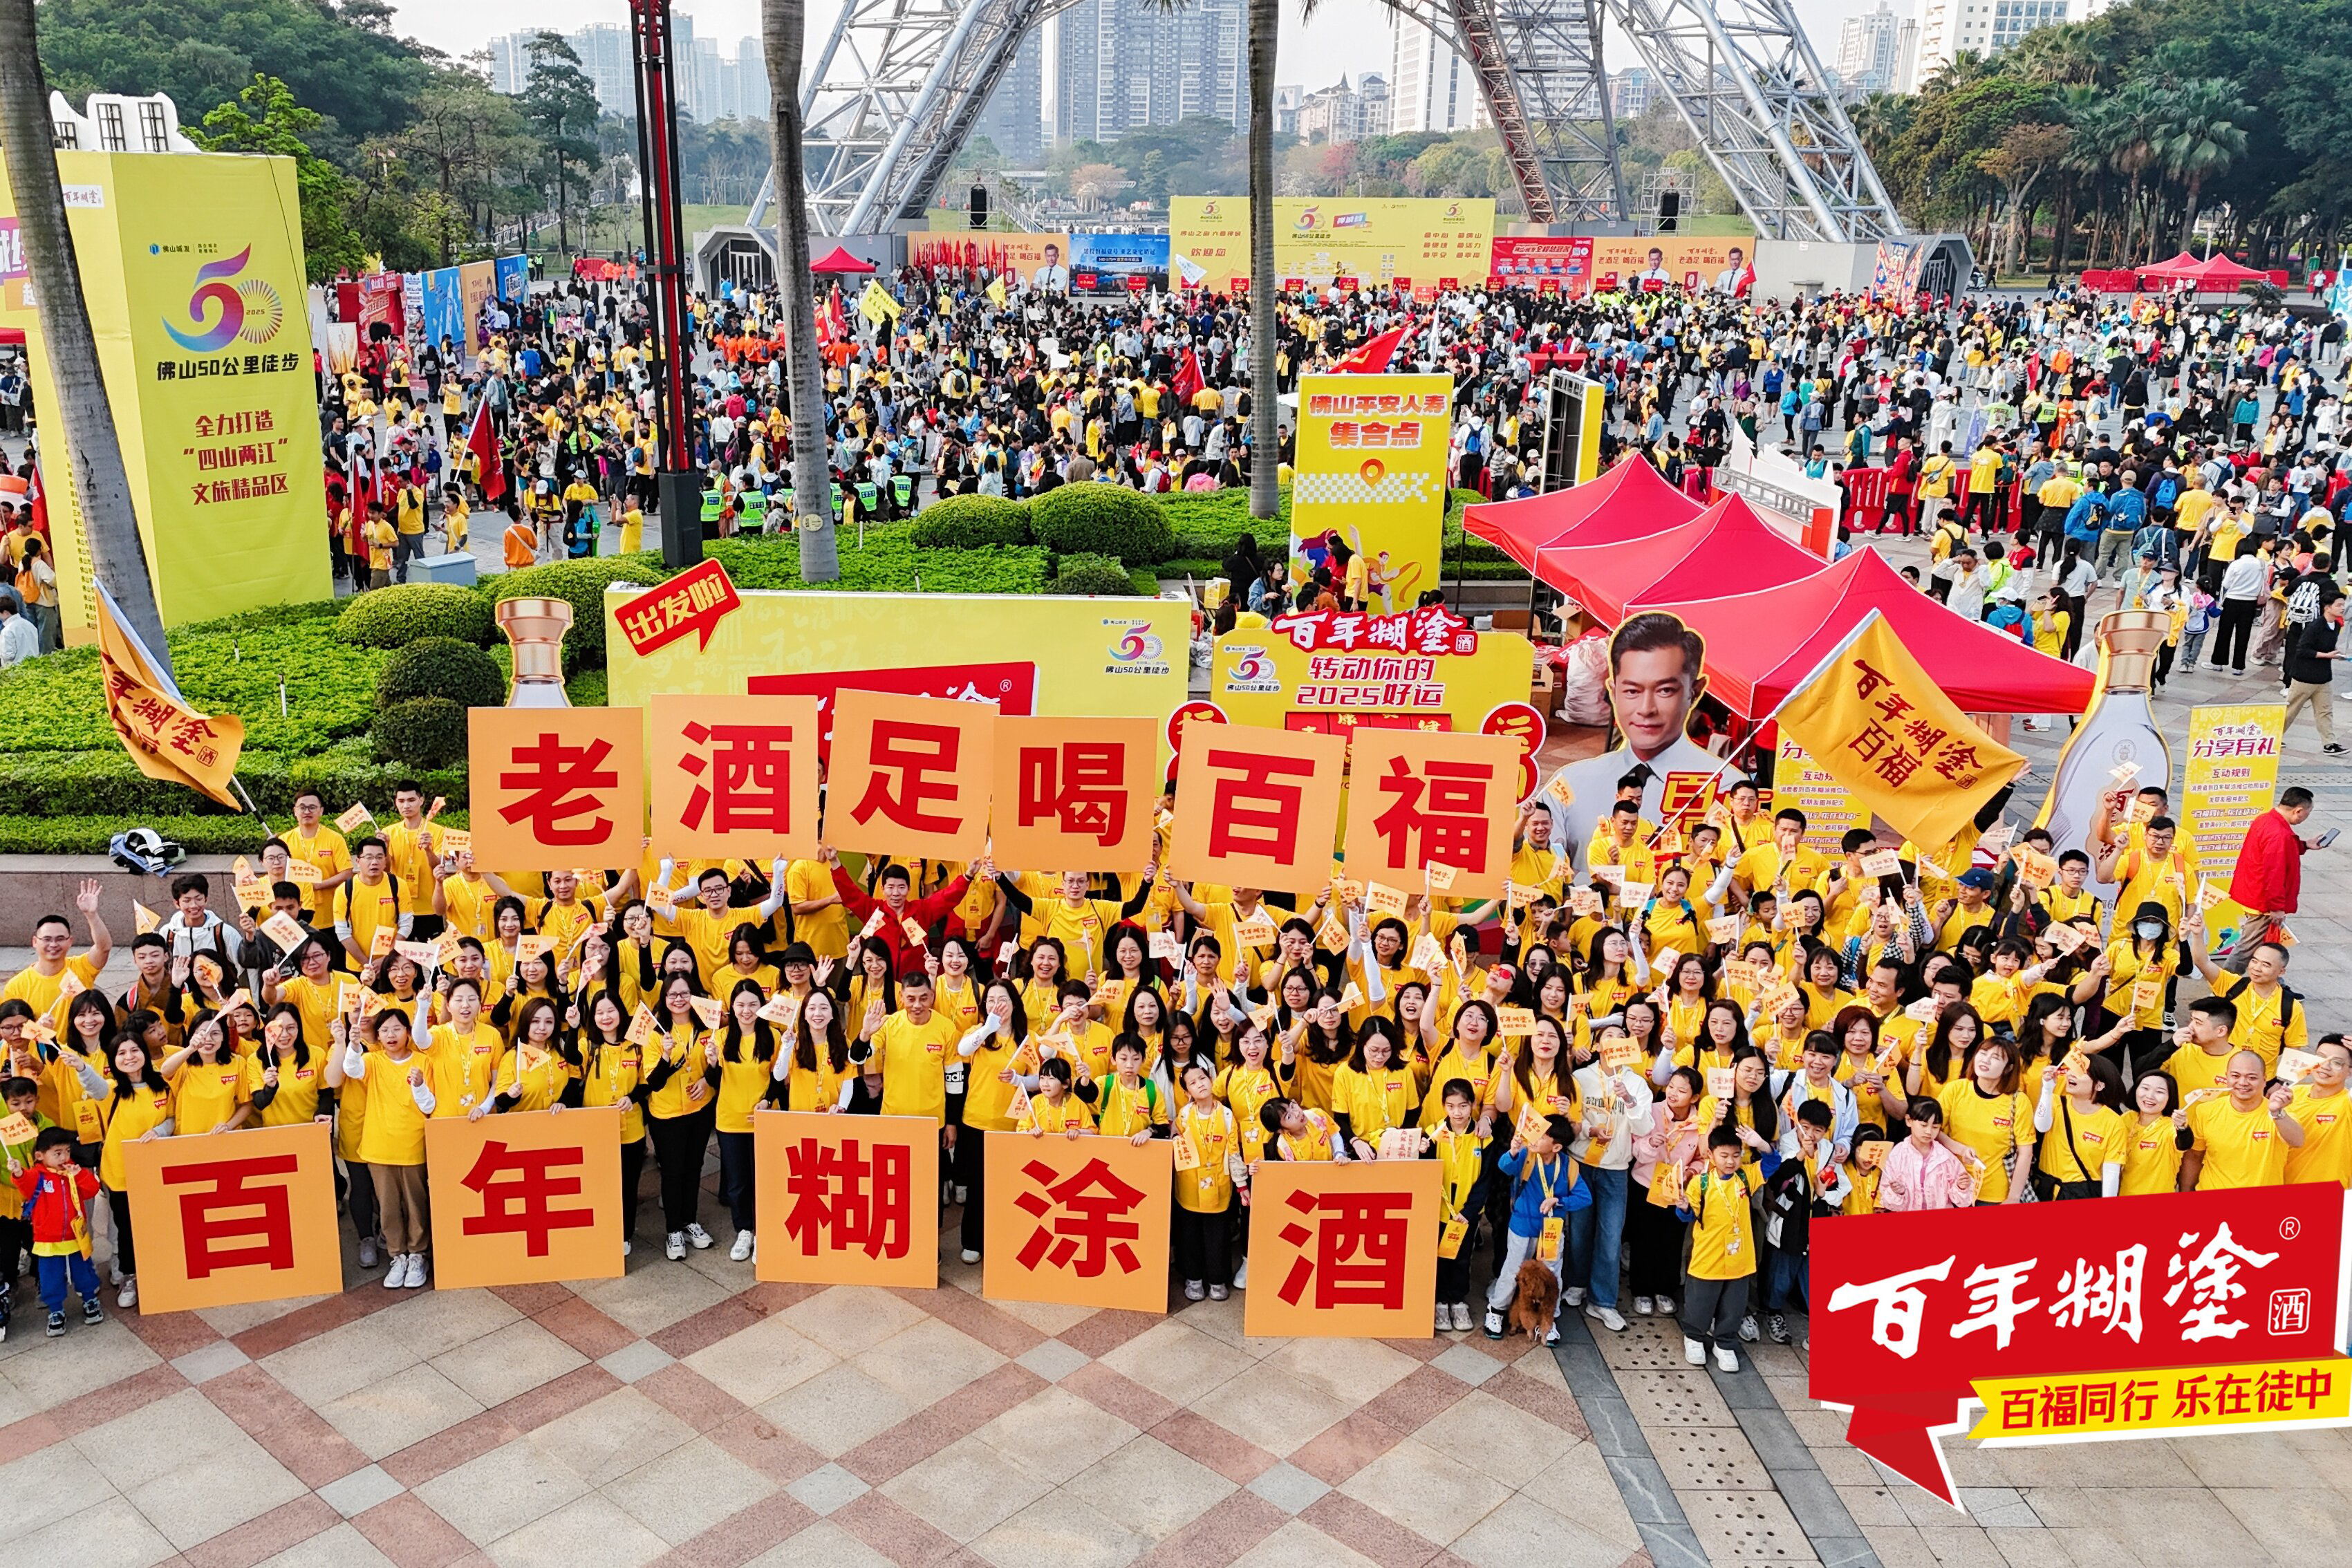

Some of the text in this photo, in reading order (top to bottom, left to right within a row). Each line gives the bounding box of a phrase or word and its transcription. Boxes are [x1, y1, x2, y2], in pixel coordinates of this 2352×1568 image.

[157, 353, 299, 381] 佛山50公里徒步
[196, 409, 274, 438] 全力打造
[1309, 395, 1446, 414] 佛山平安人寿
[1330, 422, 1421, 447] 集合点
[191, 473, 289, 506] 文旅精品区
[625, 573, 728, 645] 出发啦
[1105, 666, 1170, 674] 佛山50公里徒步
[1297, 682, 1442, 707] 2025好运
[1310, 657, 1435, 681] 转动你的
[678, 720, 793, 834] 酒
[851, 719, 964, 834] 足
[1848, 717, 1923, 788] 百福
[2193, 737, 2277, 758] 分享有礼
[2212, 768, 2250, 778] 互动规则
[498, 734, 618, 846] 老
[1018, 742, 1129, 847] 喝
[1208, 749, 1315, 866] 百
[1374, 752, 1493, 874] 福
[162, 1154, 299, 1280] 百
[460, 1140, 594, 1258] 年
[785, 1137, 911, 1260] 糊
[1014, 1157, 1148, 1278] 涂
[1278, 1188, 1412, 1310] 酒
